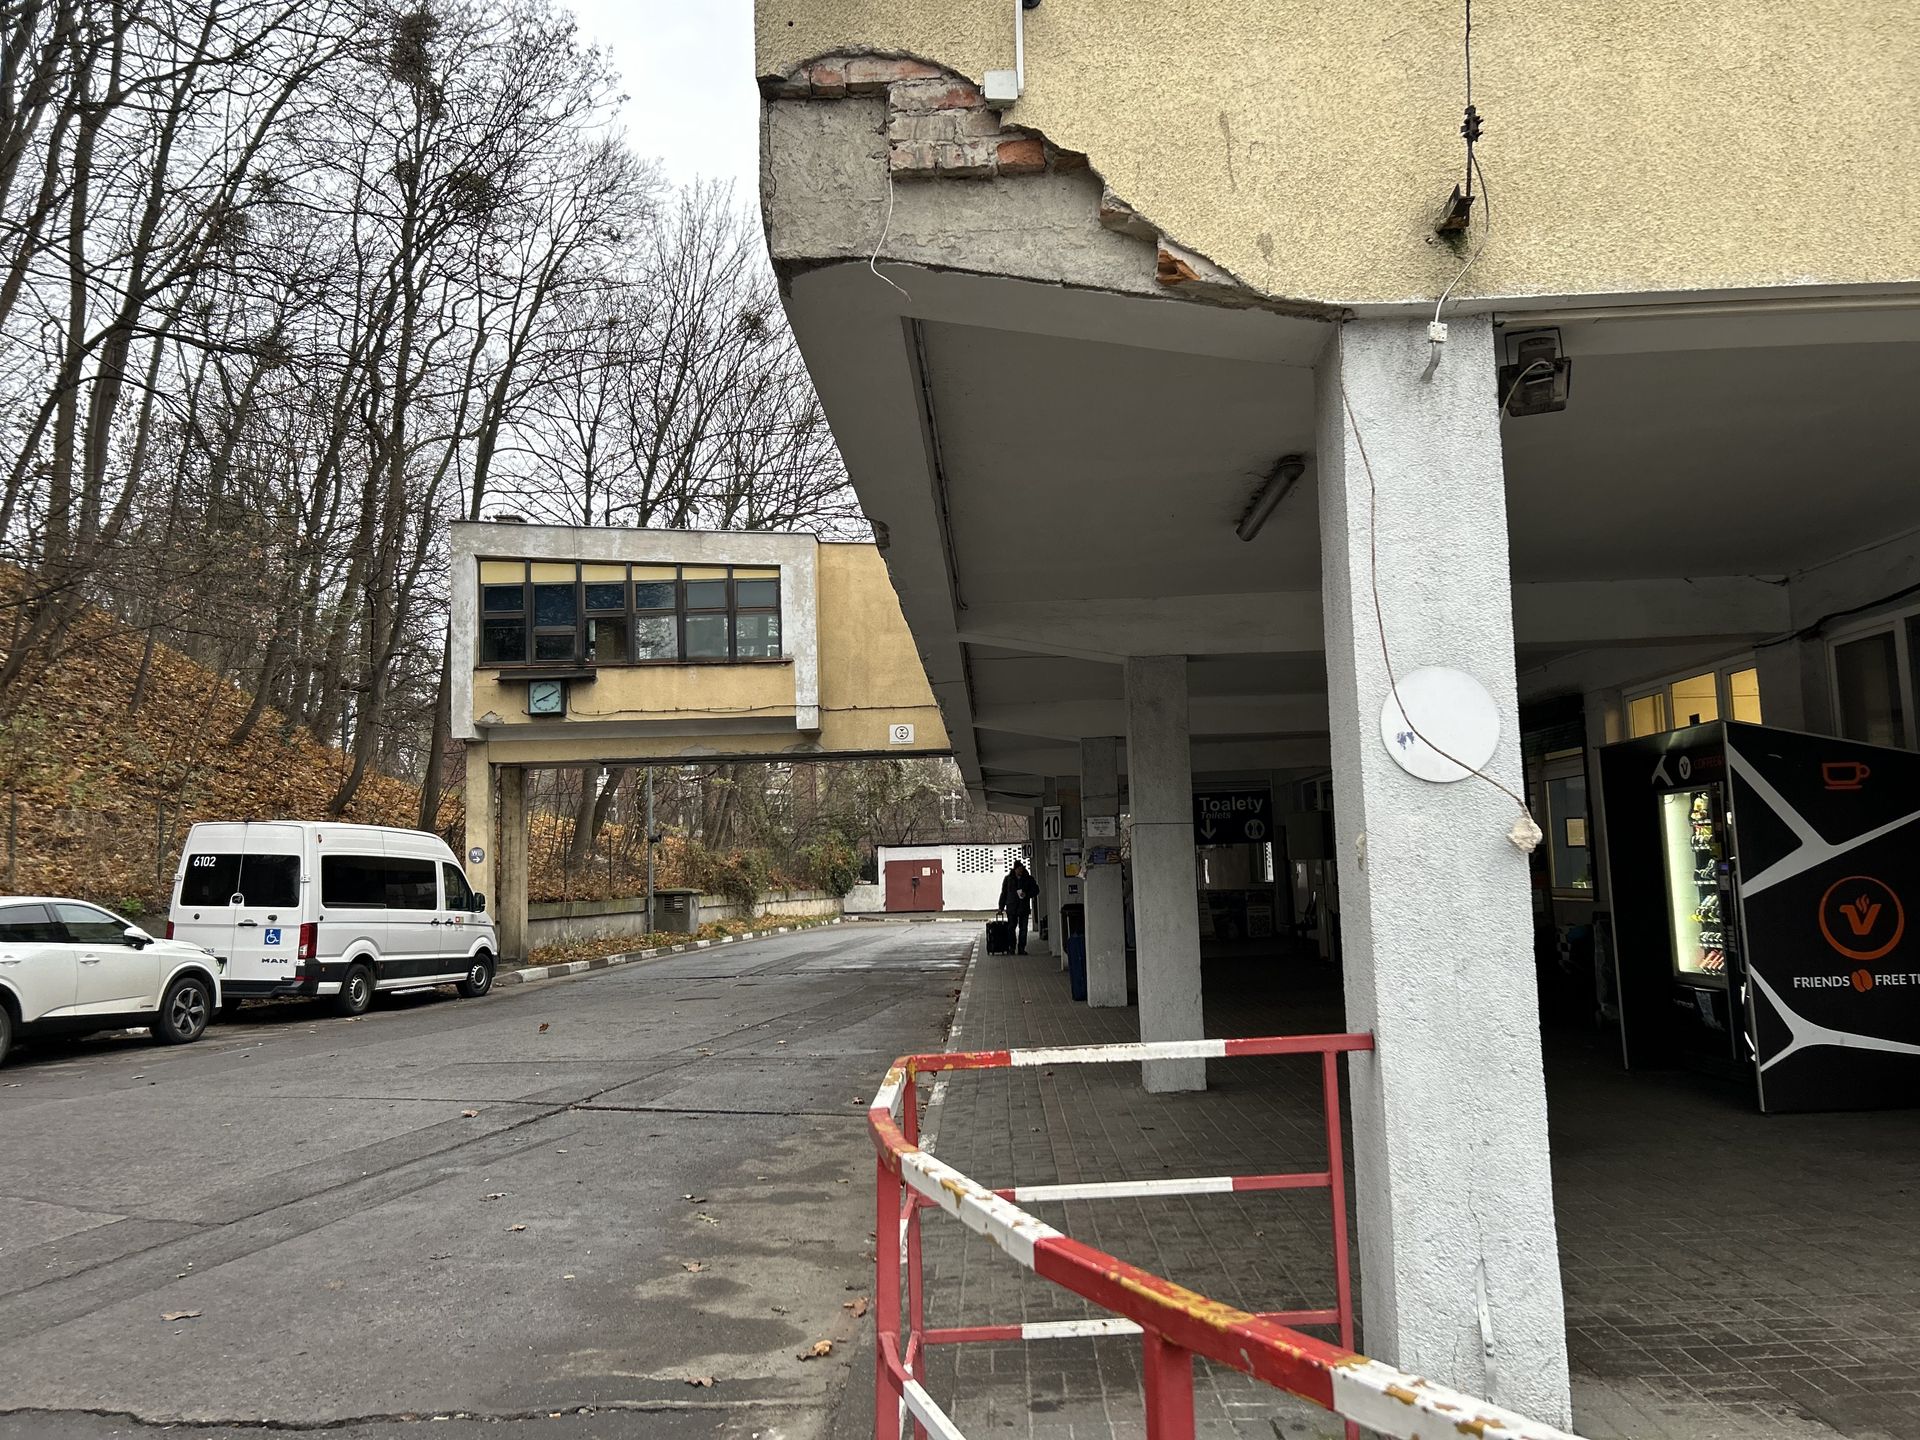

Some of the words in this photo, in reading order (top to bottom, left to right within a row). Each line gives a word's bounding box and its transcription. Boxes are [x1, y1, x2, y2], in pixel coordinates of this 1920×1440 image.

[1199, 796, 1263, 813] Toalety
[1045, 816, 1059, 838] 10
[1022, 844, 1032, 857] 10
[193, 856, 216, 867] 6102
[1793, 976, 1850, 988] FRIENDS
[1875, 974, 1907, 986] FREE
